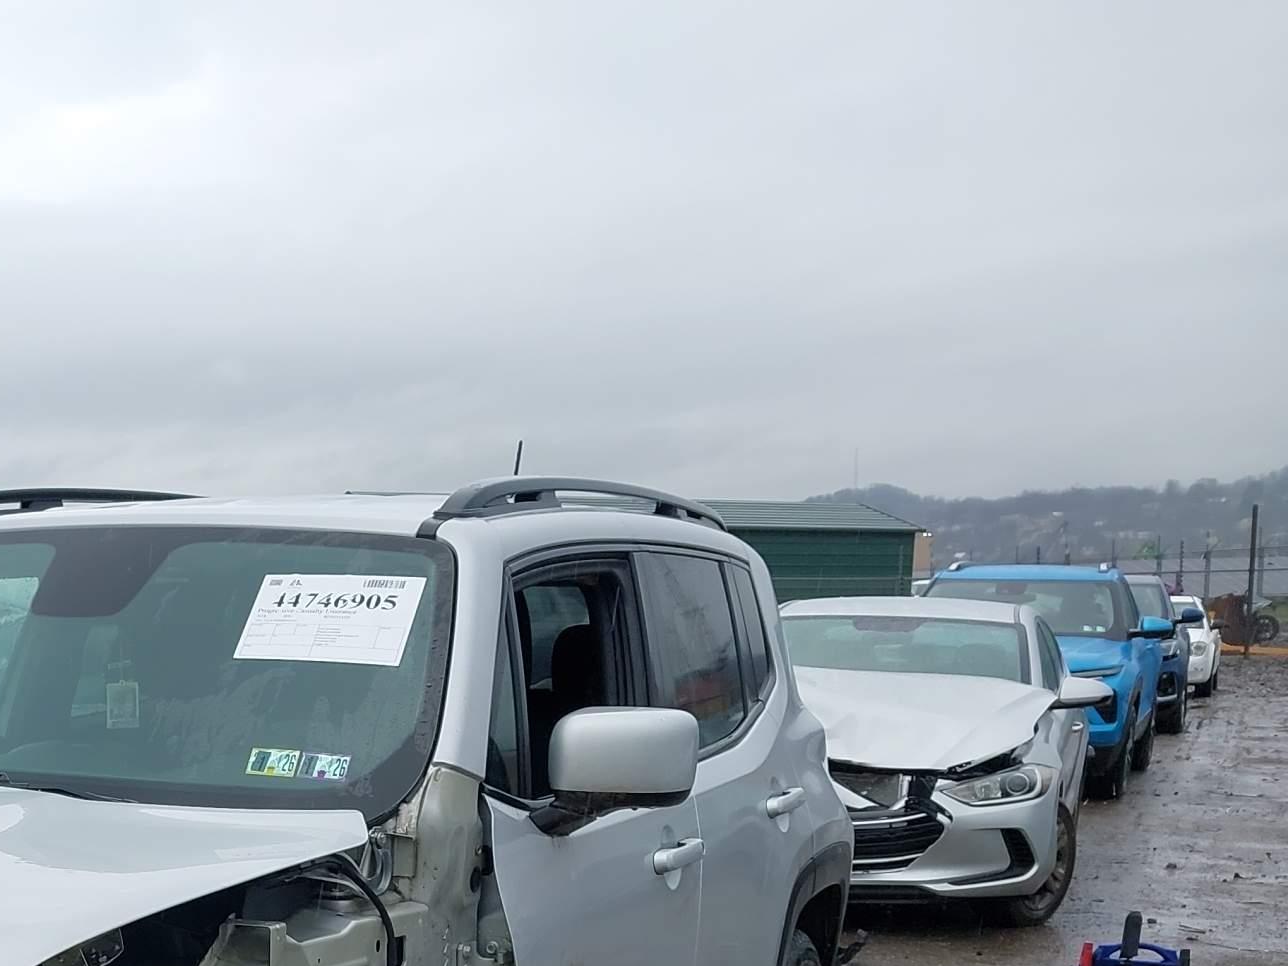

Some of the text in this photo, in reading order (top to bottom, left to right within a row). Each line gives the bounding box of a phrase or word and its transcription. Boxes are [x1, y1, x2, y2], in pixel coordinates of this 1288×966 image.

[272, 592, 399, 610] 44746905
[282, 754, 297, 771] 26
[332, 758, 348, 777] 26
